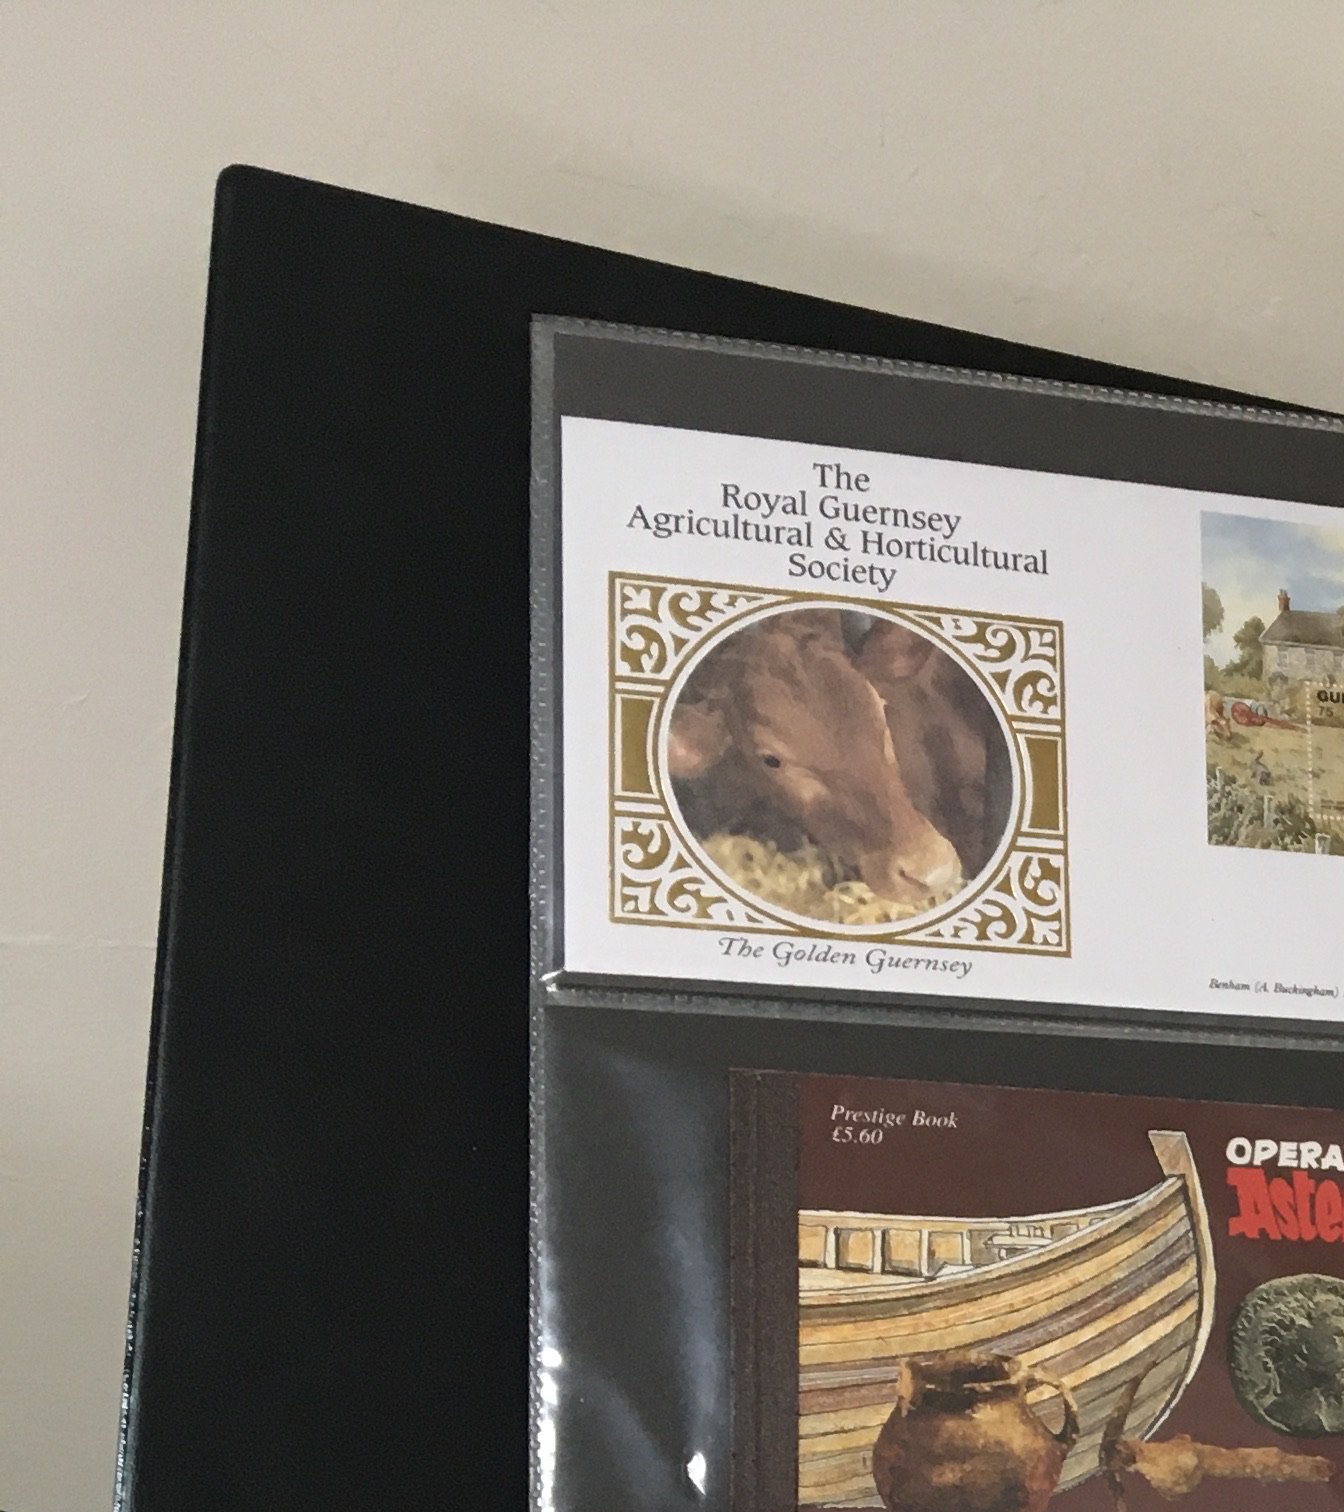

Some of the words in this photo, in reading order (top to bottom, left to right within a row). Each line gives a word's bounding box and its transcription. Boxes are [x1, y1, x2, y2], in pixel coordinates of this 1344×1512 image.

[813, 463, 870, 492] The
[721, 483, 807, 516] Royal
[819, 496, 961, 537] Guernsey
[627, 505, 812, 547] Agricultural
[824, 528, 848, 550] &
[861, 531, 1048, 575] Horticultural
[788, 554, 896, 593] Society
[718, 937, 763, 958] The
[773, 943, 855, 966] Golden
[866, 949, 972, 977] Guernsey
[1209, 978, 1250, 990] Benham
[830, 1105, 906, 1129] Prestige
[912, 1109, 958, 1129] Book
[832, 1127, 884, 1146] £5.60
